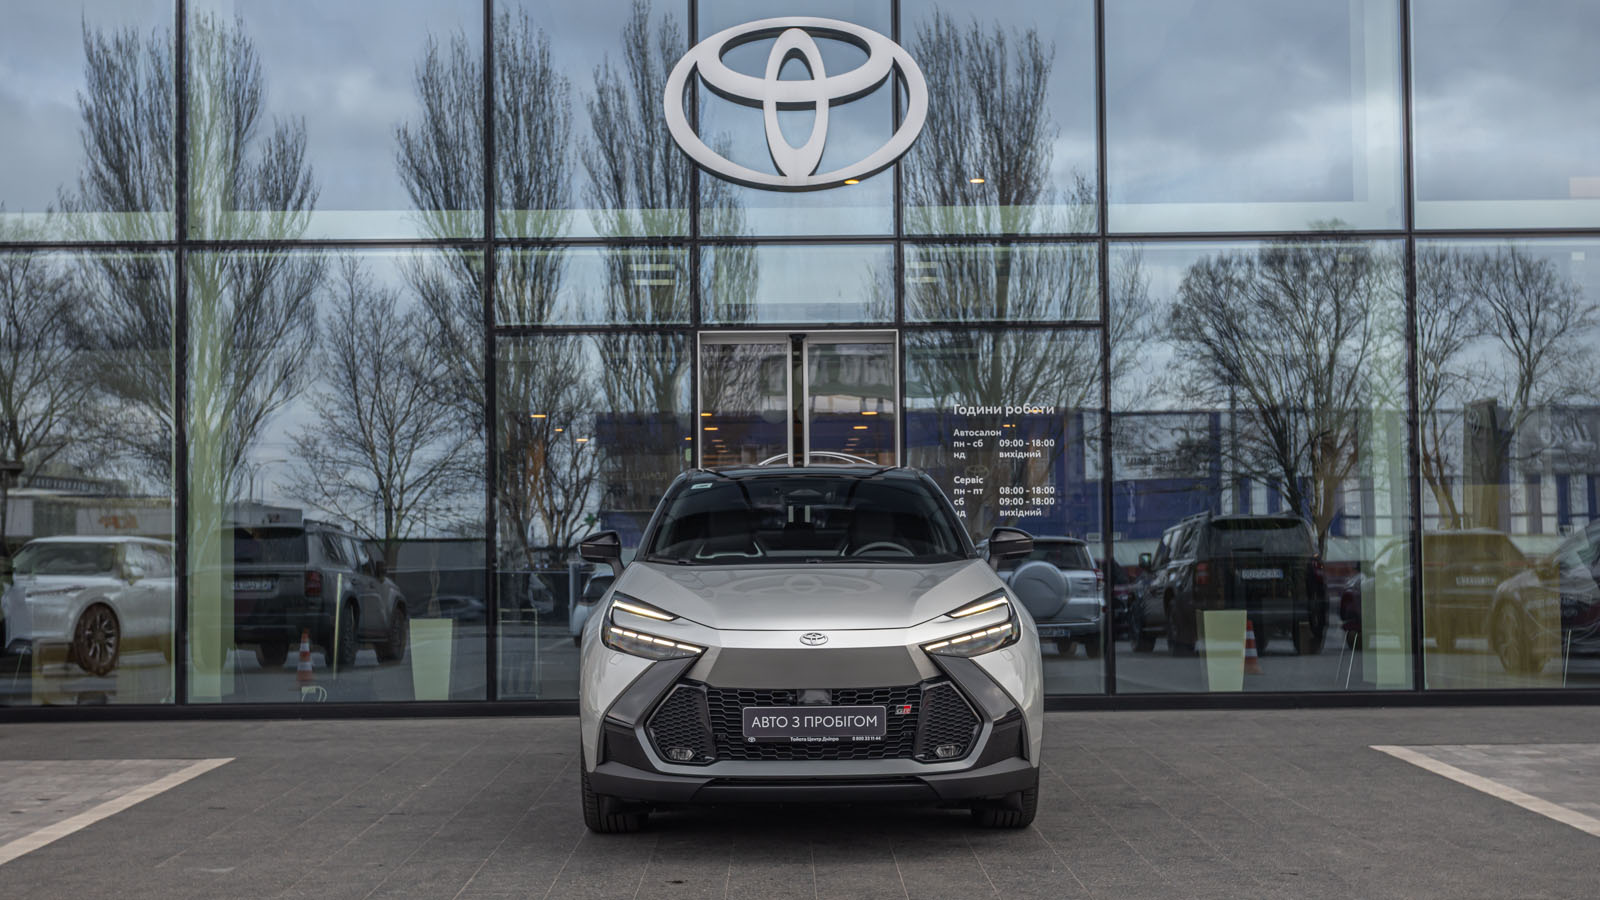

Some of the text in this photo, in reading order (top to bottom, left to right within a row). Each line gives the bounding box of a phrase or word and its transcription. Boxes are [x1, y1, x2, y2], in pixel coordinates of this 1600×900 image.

[953, 402, 1055, 417] Години роботи
[953, 429, 1002, 437] Автосалон
[972, 439, 984, 447] сб
[999, 439, 1024, 447] 09:00
[1031, 439, 1055, 447] 18:00
[953, 450, 1041, 459] нд вихідний
[953, 476, 984, 485] Сервіс
[999, 486, 1024, 494] 08:00
[1031, 486, 1055, 494] 18:00
[953, 497, 965, 506] сб
[999, 497, 1024, 505] 09:00
[1031, 497, 1055, 505] 18:00
[999, 508, 1042, 517] вихідний
[751, 716, 789, 729] АВТО
[804, 715, 878, 728] ПРОБІГОМ
